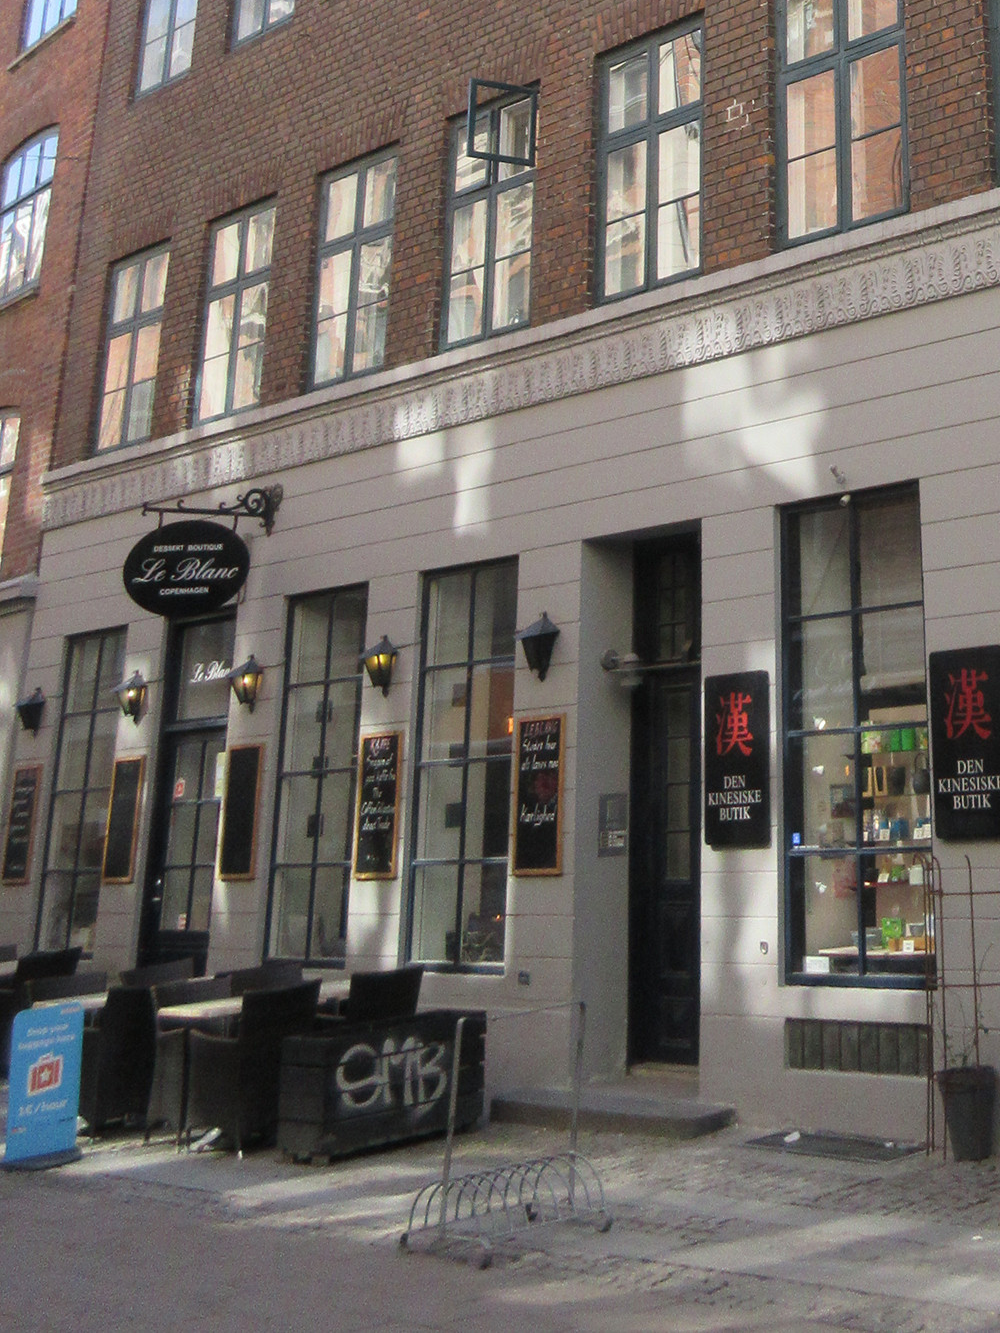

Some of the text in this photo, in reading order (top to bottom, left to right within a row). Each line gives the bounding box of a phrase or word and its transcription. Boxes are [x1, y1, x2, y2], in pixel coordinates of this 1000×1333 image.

[153, 543, 224, 553] DESSERT BOUTIQUE
[131, 557, 239, 583] Le Blanc
[159, 586, 210, 596] COPENHAGEN
[190, 660, 231, 683] Le Blan
[944, 668, 992, 740] 漢
[716, 692, 754, 757] 漢
[957, 759, 984, 775] DEN
[724, 775, 746, 789] DEN
[708, 789, 762, 806] KINESISKE
[952, 793, 992, 810] BUTIK
[719, 806, 751, 821] BUTIK
